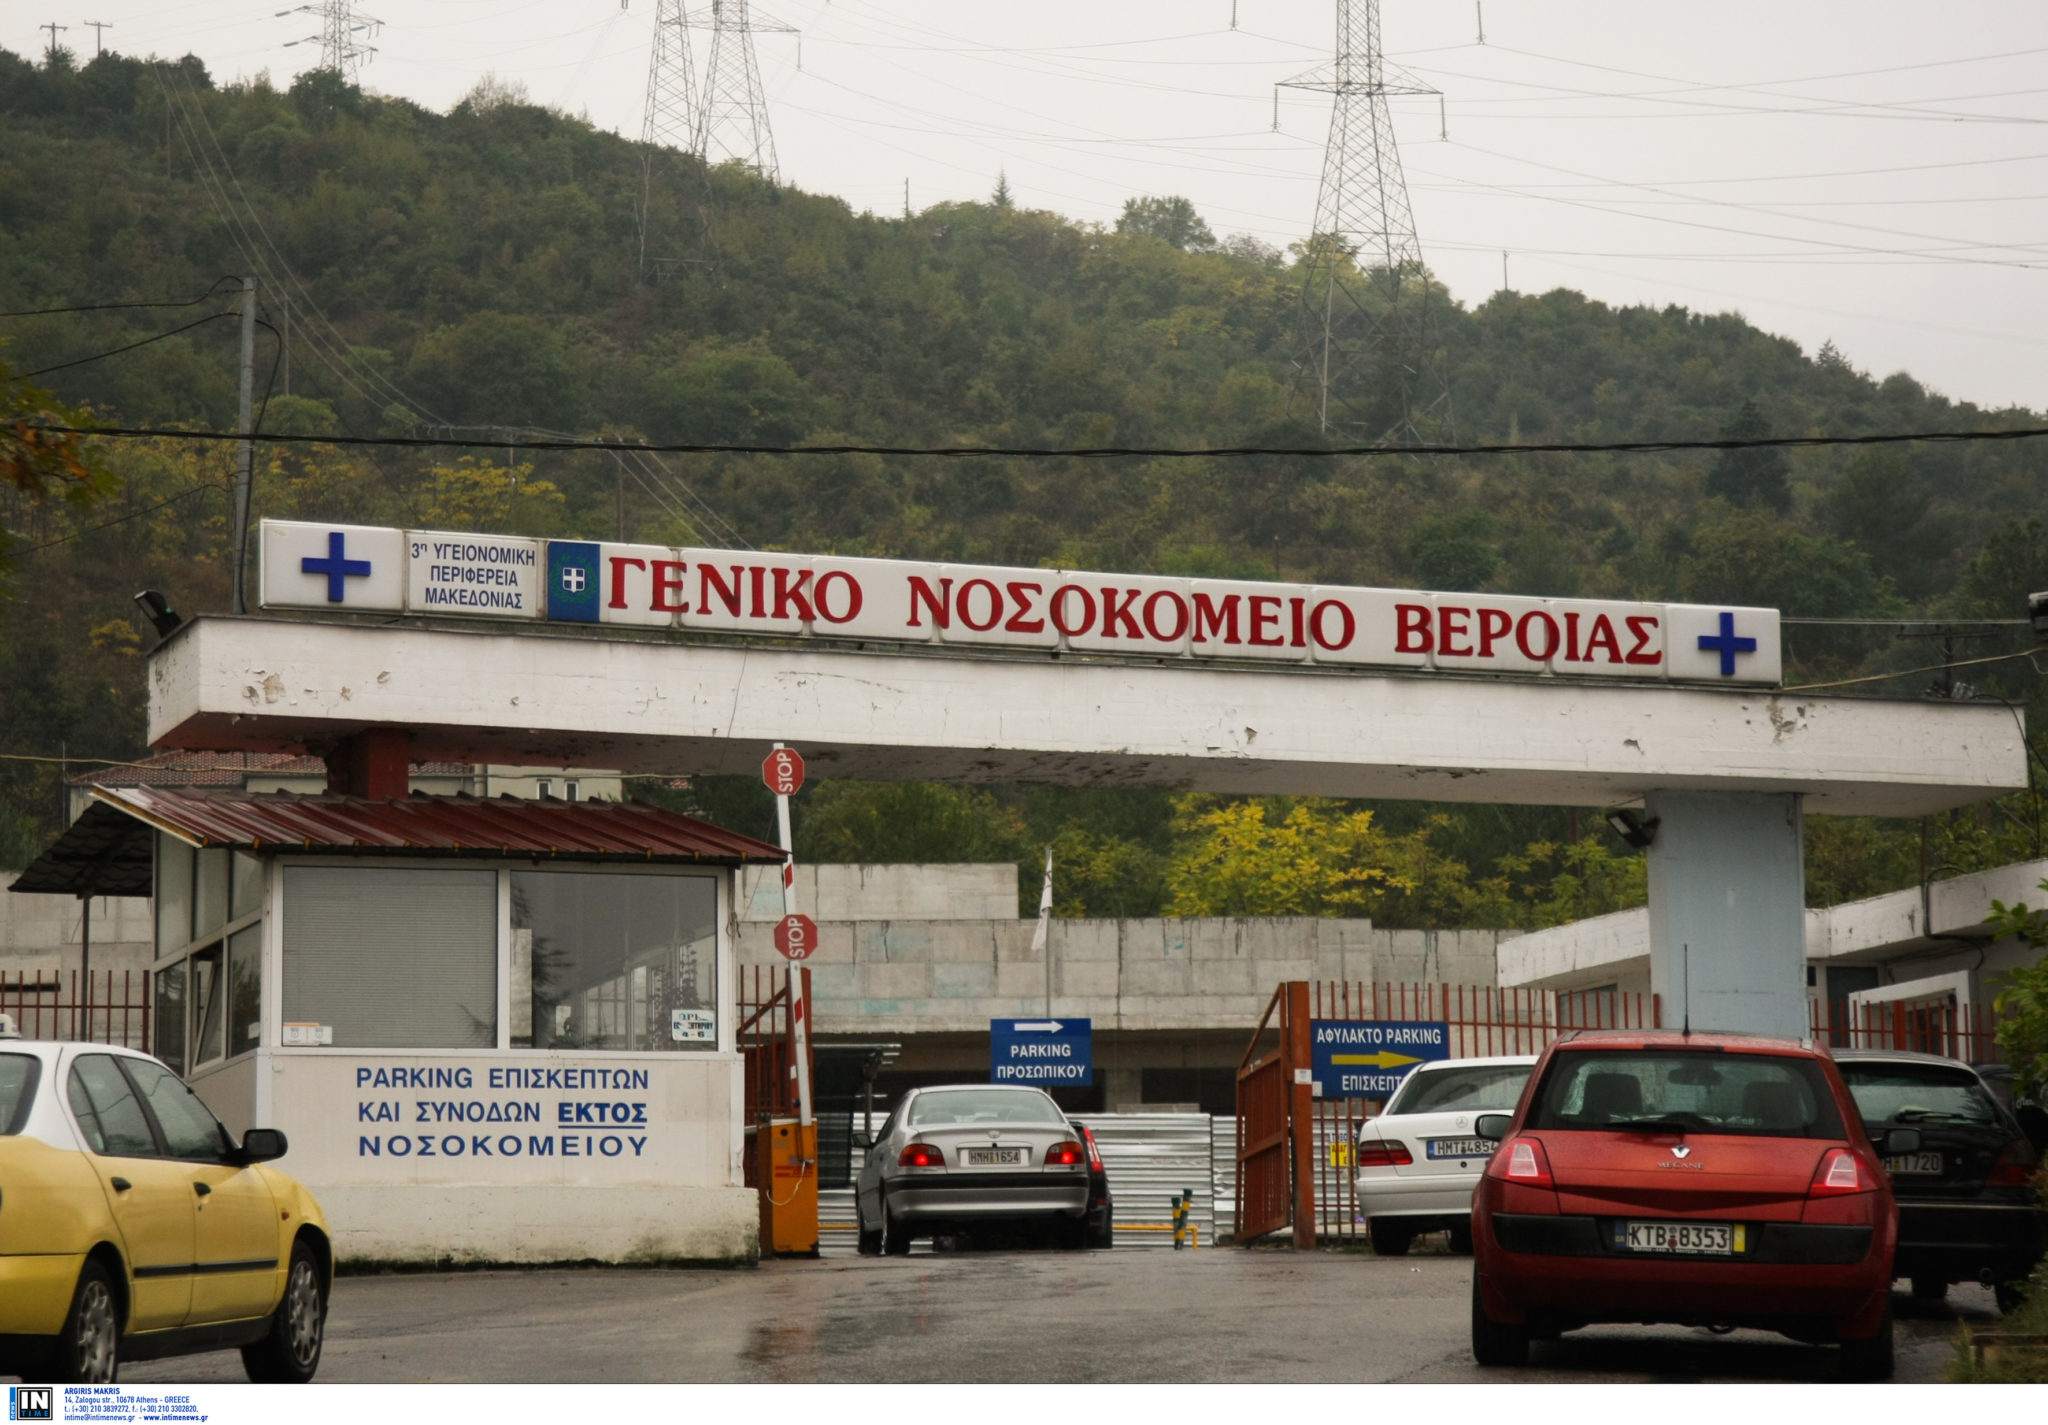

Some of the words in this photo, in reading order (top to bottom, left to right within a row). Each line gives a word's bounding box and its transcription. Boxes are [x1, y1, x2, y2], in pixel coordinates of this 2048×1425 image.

[433, 543, 536, 566] ΥΓΕΙΟΝΟΜΙΚΗ
[430, 565, 518, 586] ΠΕΡΙΦΕΡΕΙΑ
[425, 587, 523, 610] ΜΑΚΕΔΟΝΙΑΣ
[607, 556, 862, 624] ΓΕΝΙΚΟ
[906, 575, 1356, 651] ΝΟΣΟΚΟΜΕΙΟ
[1395, 604, 1663, 665] ΒΕΡΟΙΑΣ
[776, 752, 793, 793] STOP
[787, 917, 806, 958] STOP
[1317, 1028, 1383, 1044] ΑΦΥΛΑΚΤΟ
[1386, 1028, 1441, 1044] PARKING
[1010, 1044, 1071, 1058] PARKING
[357, 1067, 473, 1089] PARKING
[489, 1067, 649, 1090] ΕΠΙΣΚΕΠΤΩΝ
[997, 1065, 1085, 1079] ΠΡΟΣΩΠΙΚΟΥ
[1342, 1075, 1402, 1091] ΕΠΙΣΚΕΠΤ
[358, 1101, 400, 1123] ΚΑΙ
[415, 1101, 540, 1123] ΣΥΝΟΔΩΝ
[557, 1101, 648, 1124] ΕΚΤΟΣ
[359, 1134, 648, 1157] ΝΟΣΟΚΟΜΕΙΟΥ
